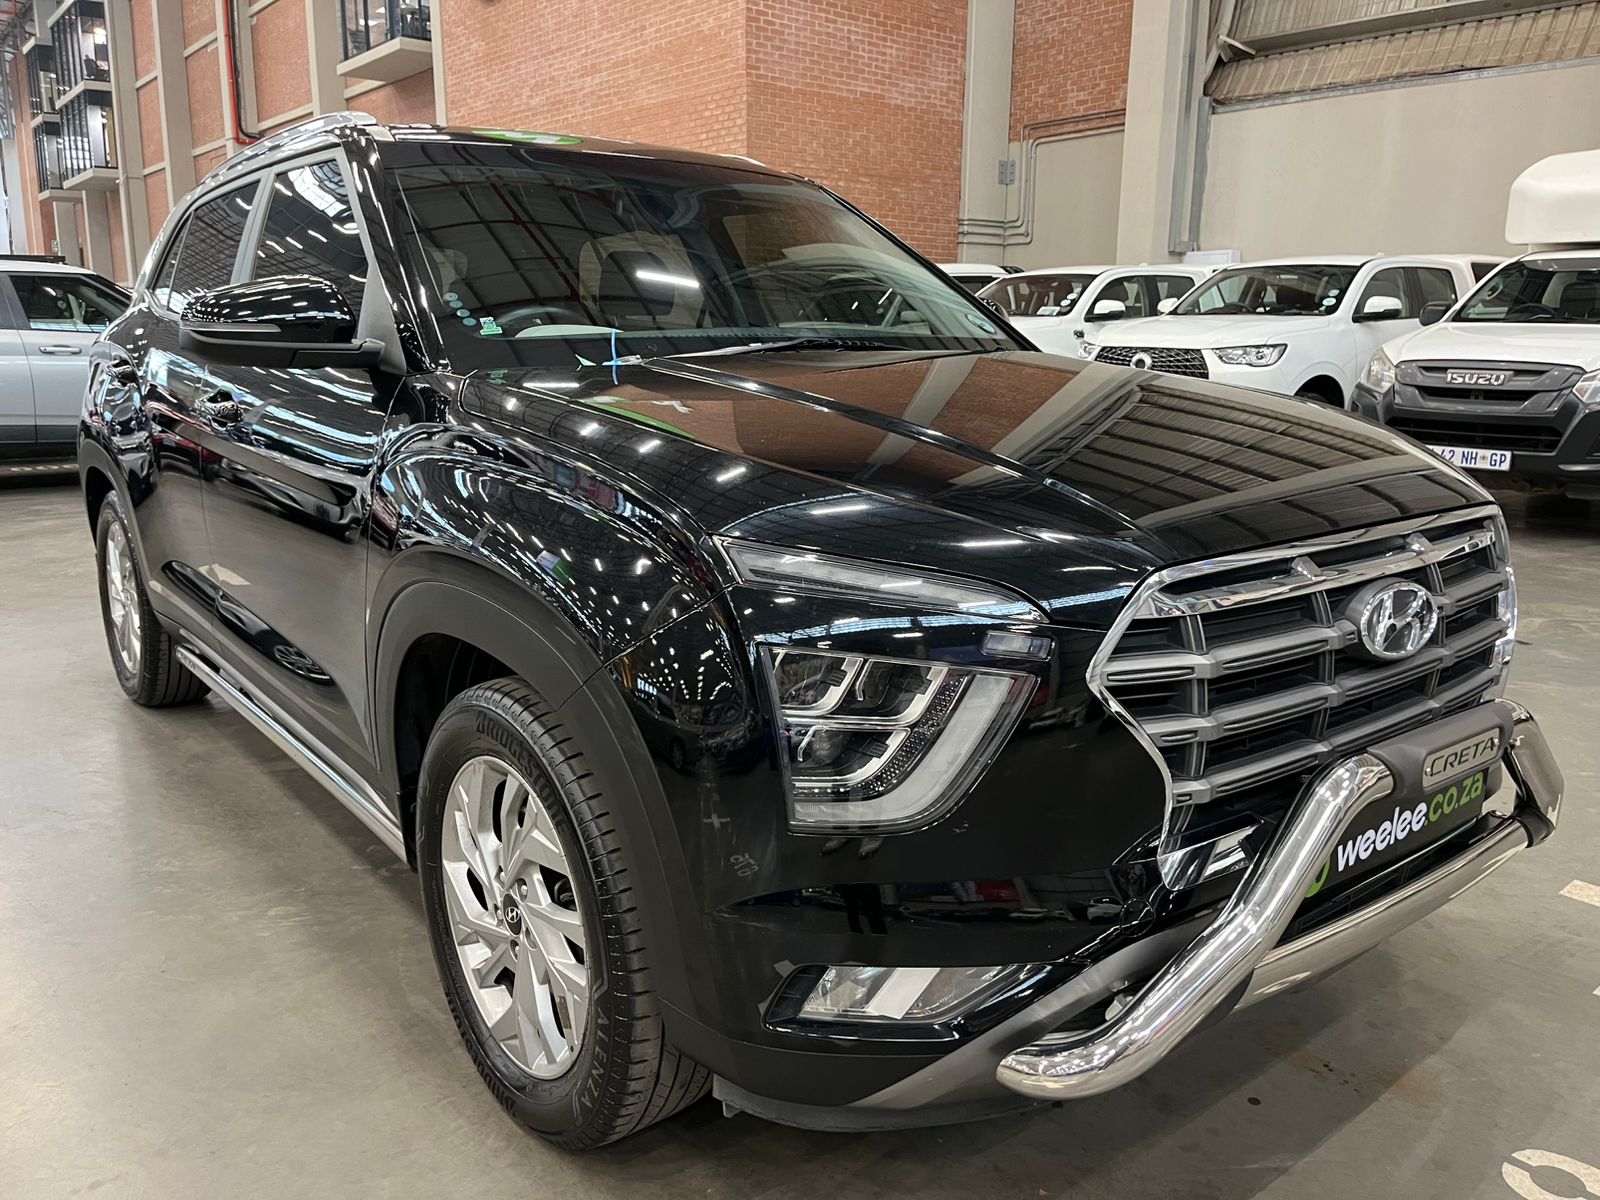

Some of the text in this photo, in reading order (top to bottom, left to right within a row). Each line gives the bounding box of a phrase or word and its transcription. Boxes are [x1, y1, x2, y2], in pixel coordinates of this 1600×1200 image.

[1447, 372, 1504, 385] ISUZU
[1461, 450, 1478, 465] NH
[1489, 452, 1508, 467] GP
[1430, 736, 1496, 777] CRETA
[581, 1007, 610, 1108] ALENZA
